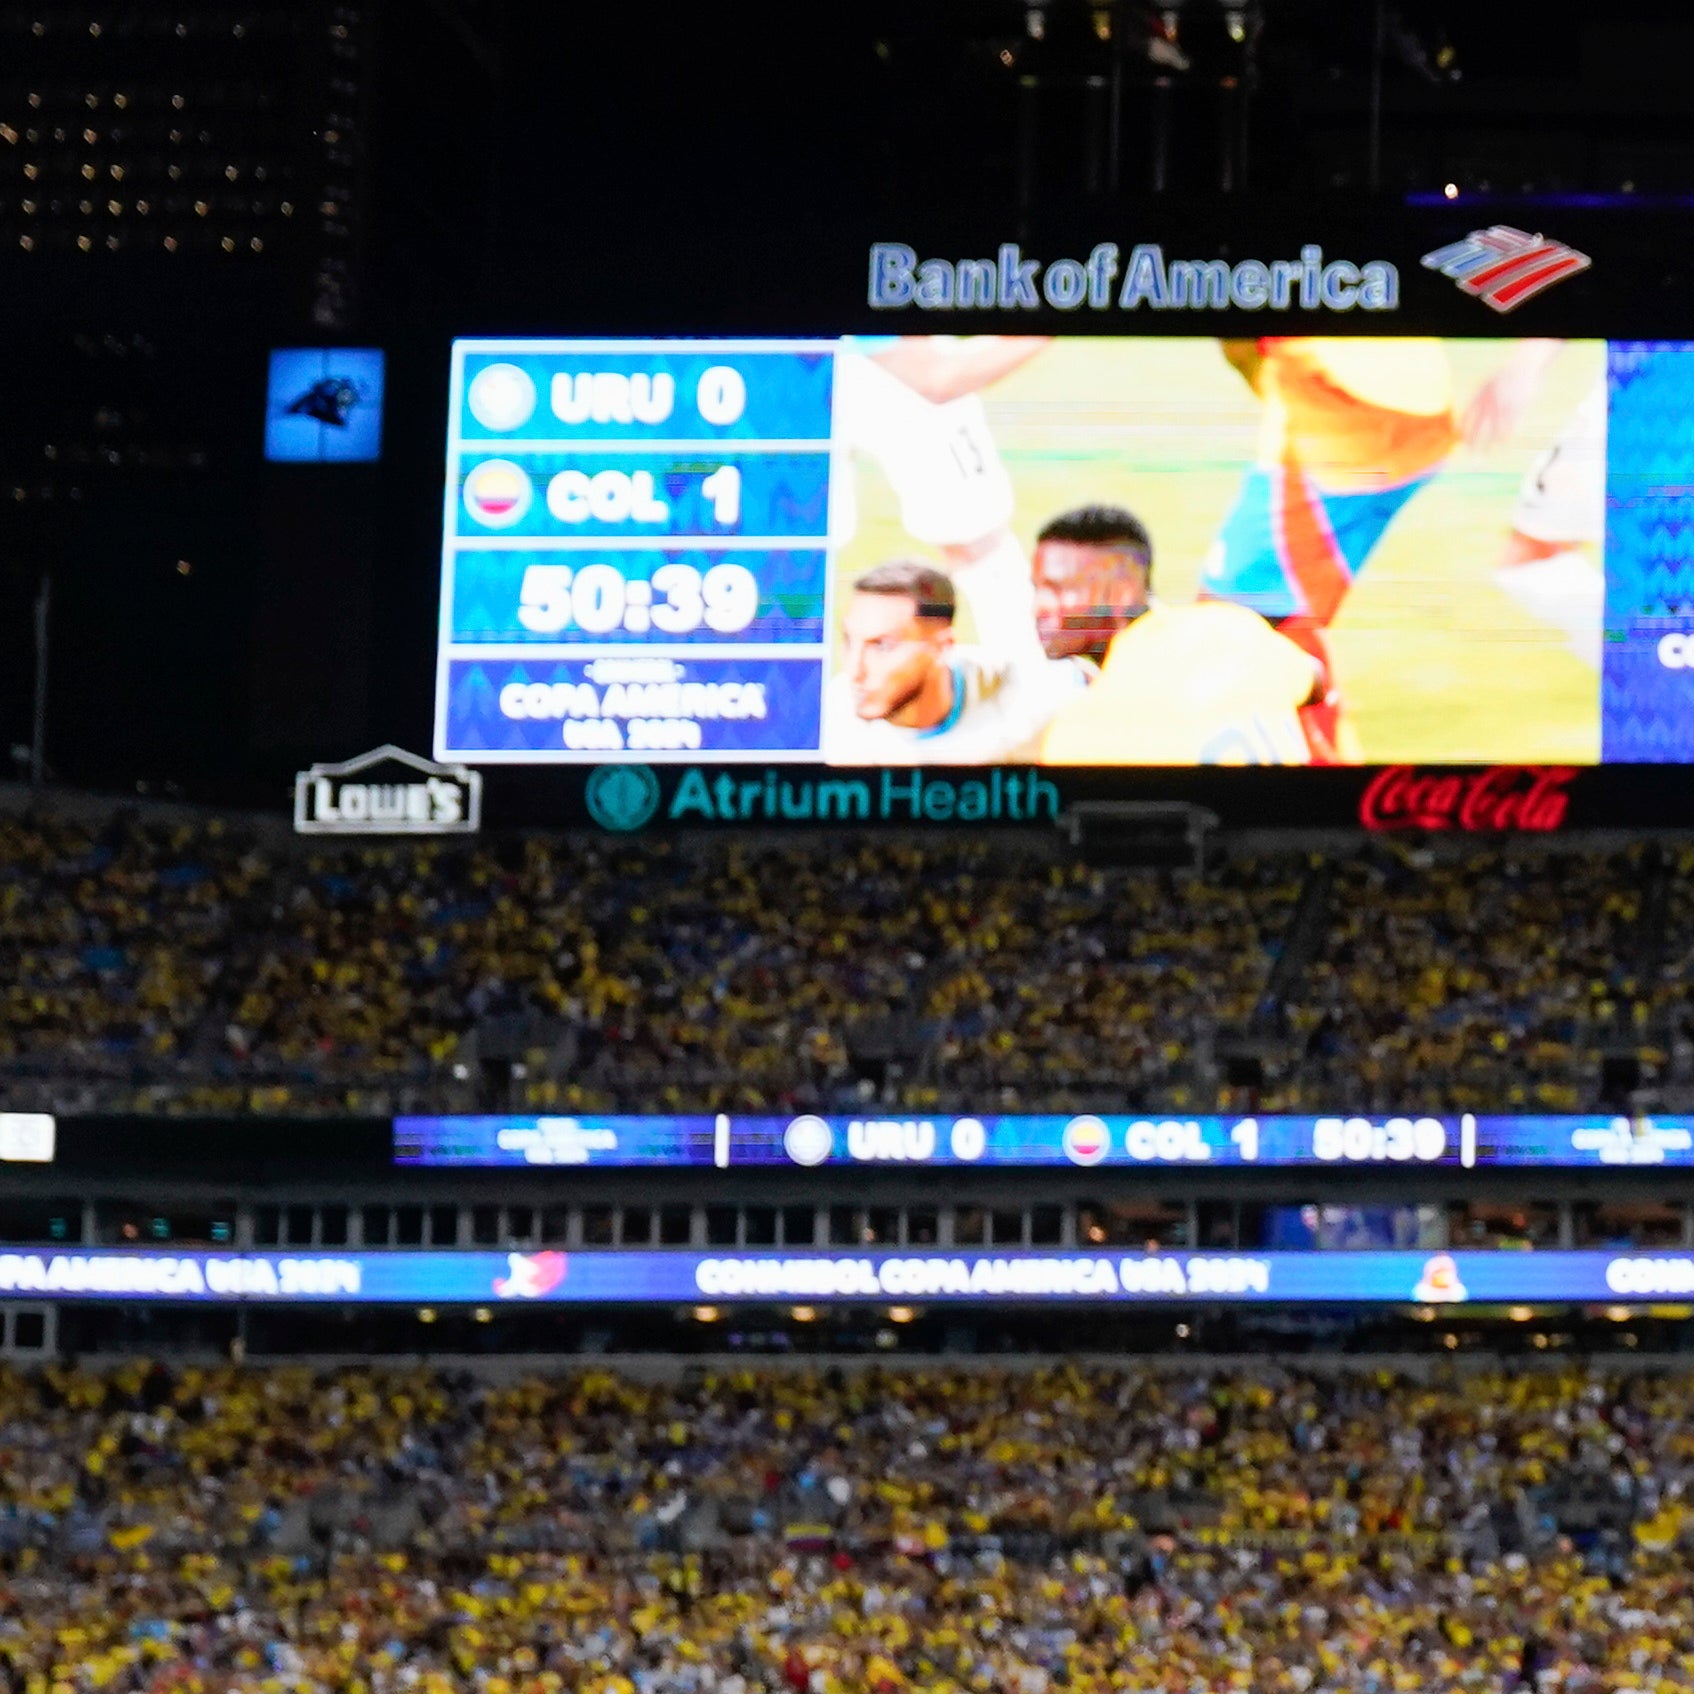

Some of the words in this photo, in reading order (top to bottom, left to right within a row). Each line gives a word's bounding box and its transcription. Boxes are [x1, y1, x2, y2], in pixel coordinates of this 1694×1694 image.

[868, 242, 1041, 311] Bank
[1043, 242, 1118, 311] of
[1119, 243, 1400, 311] America
[551, 372, 675, 424] URU
[697, 366, 746, 425] 0
[546, 470, 670, 523] COL
[702, 466, 741, 525] 1
[518, 563, 758, 633] 50:39
[668, 767, 870, 820] Atrium
[880, 767, 1058, 820] Health
[847, 1119, 935, 1161] URU
[951, 1118, 985, 1160] 0
[1125, 1119, 1211, 1161] COL
[1230, 1118, 1259, 1160] 1
